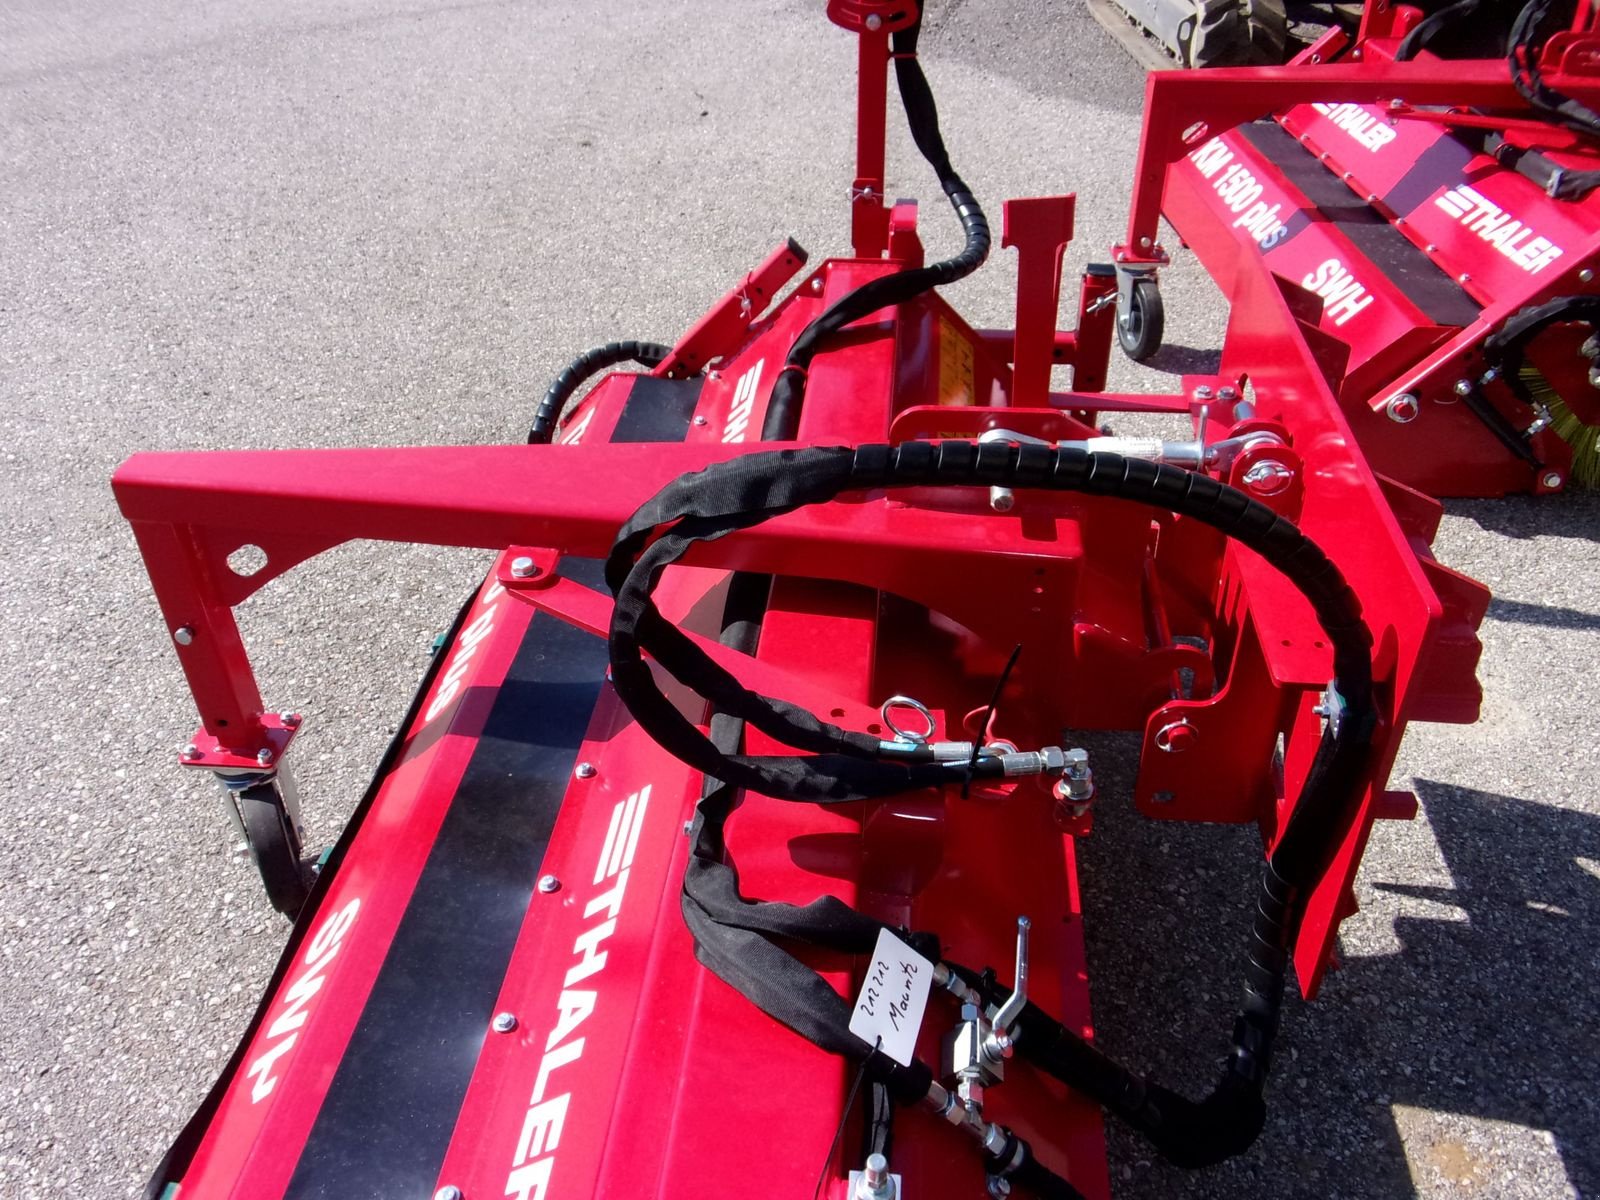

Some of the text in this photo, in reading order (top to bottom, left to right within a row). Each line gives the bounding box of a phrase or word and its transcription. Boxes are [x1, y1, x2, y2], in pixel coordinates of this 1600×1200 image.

[1213, 163, 1264, 213] 1500
[1232, 201, 1288, 248] plus
[1301, 258, 1375, 327] SWH
[425, 603, 498, 722] plus
[246, 897, 361, 1104] SWH
